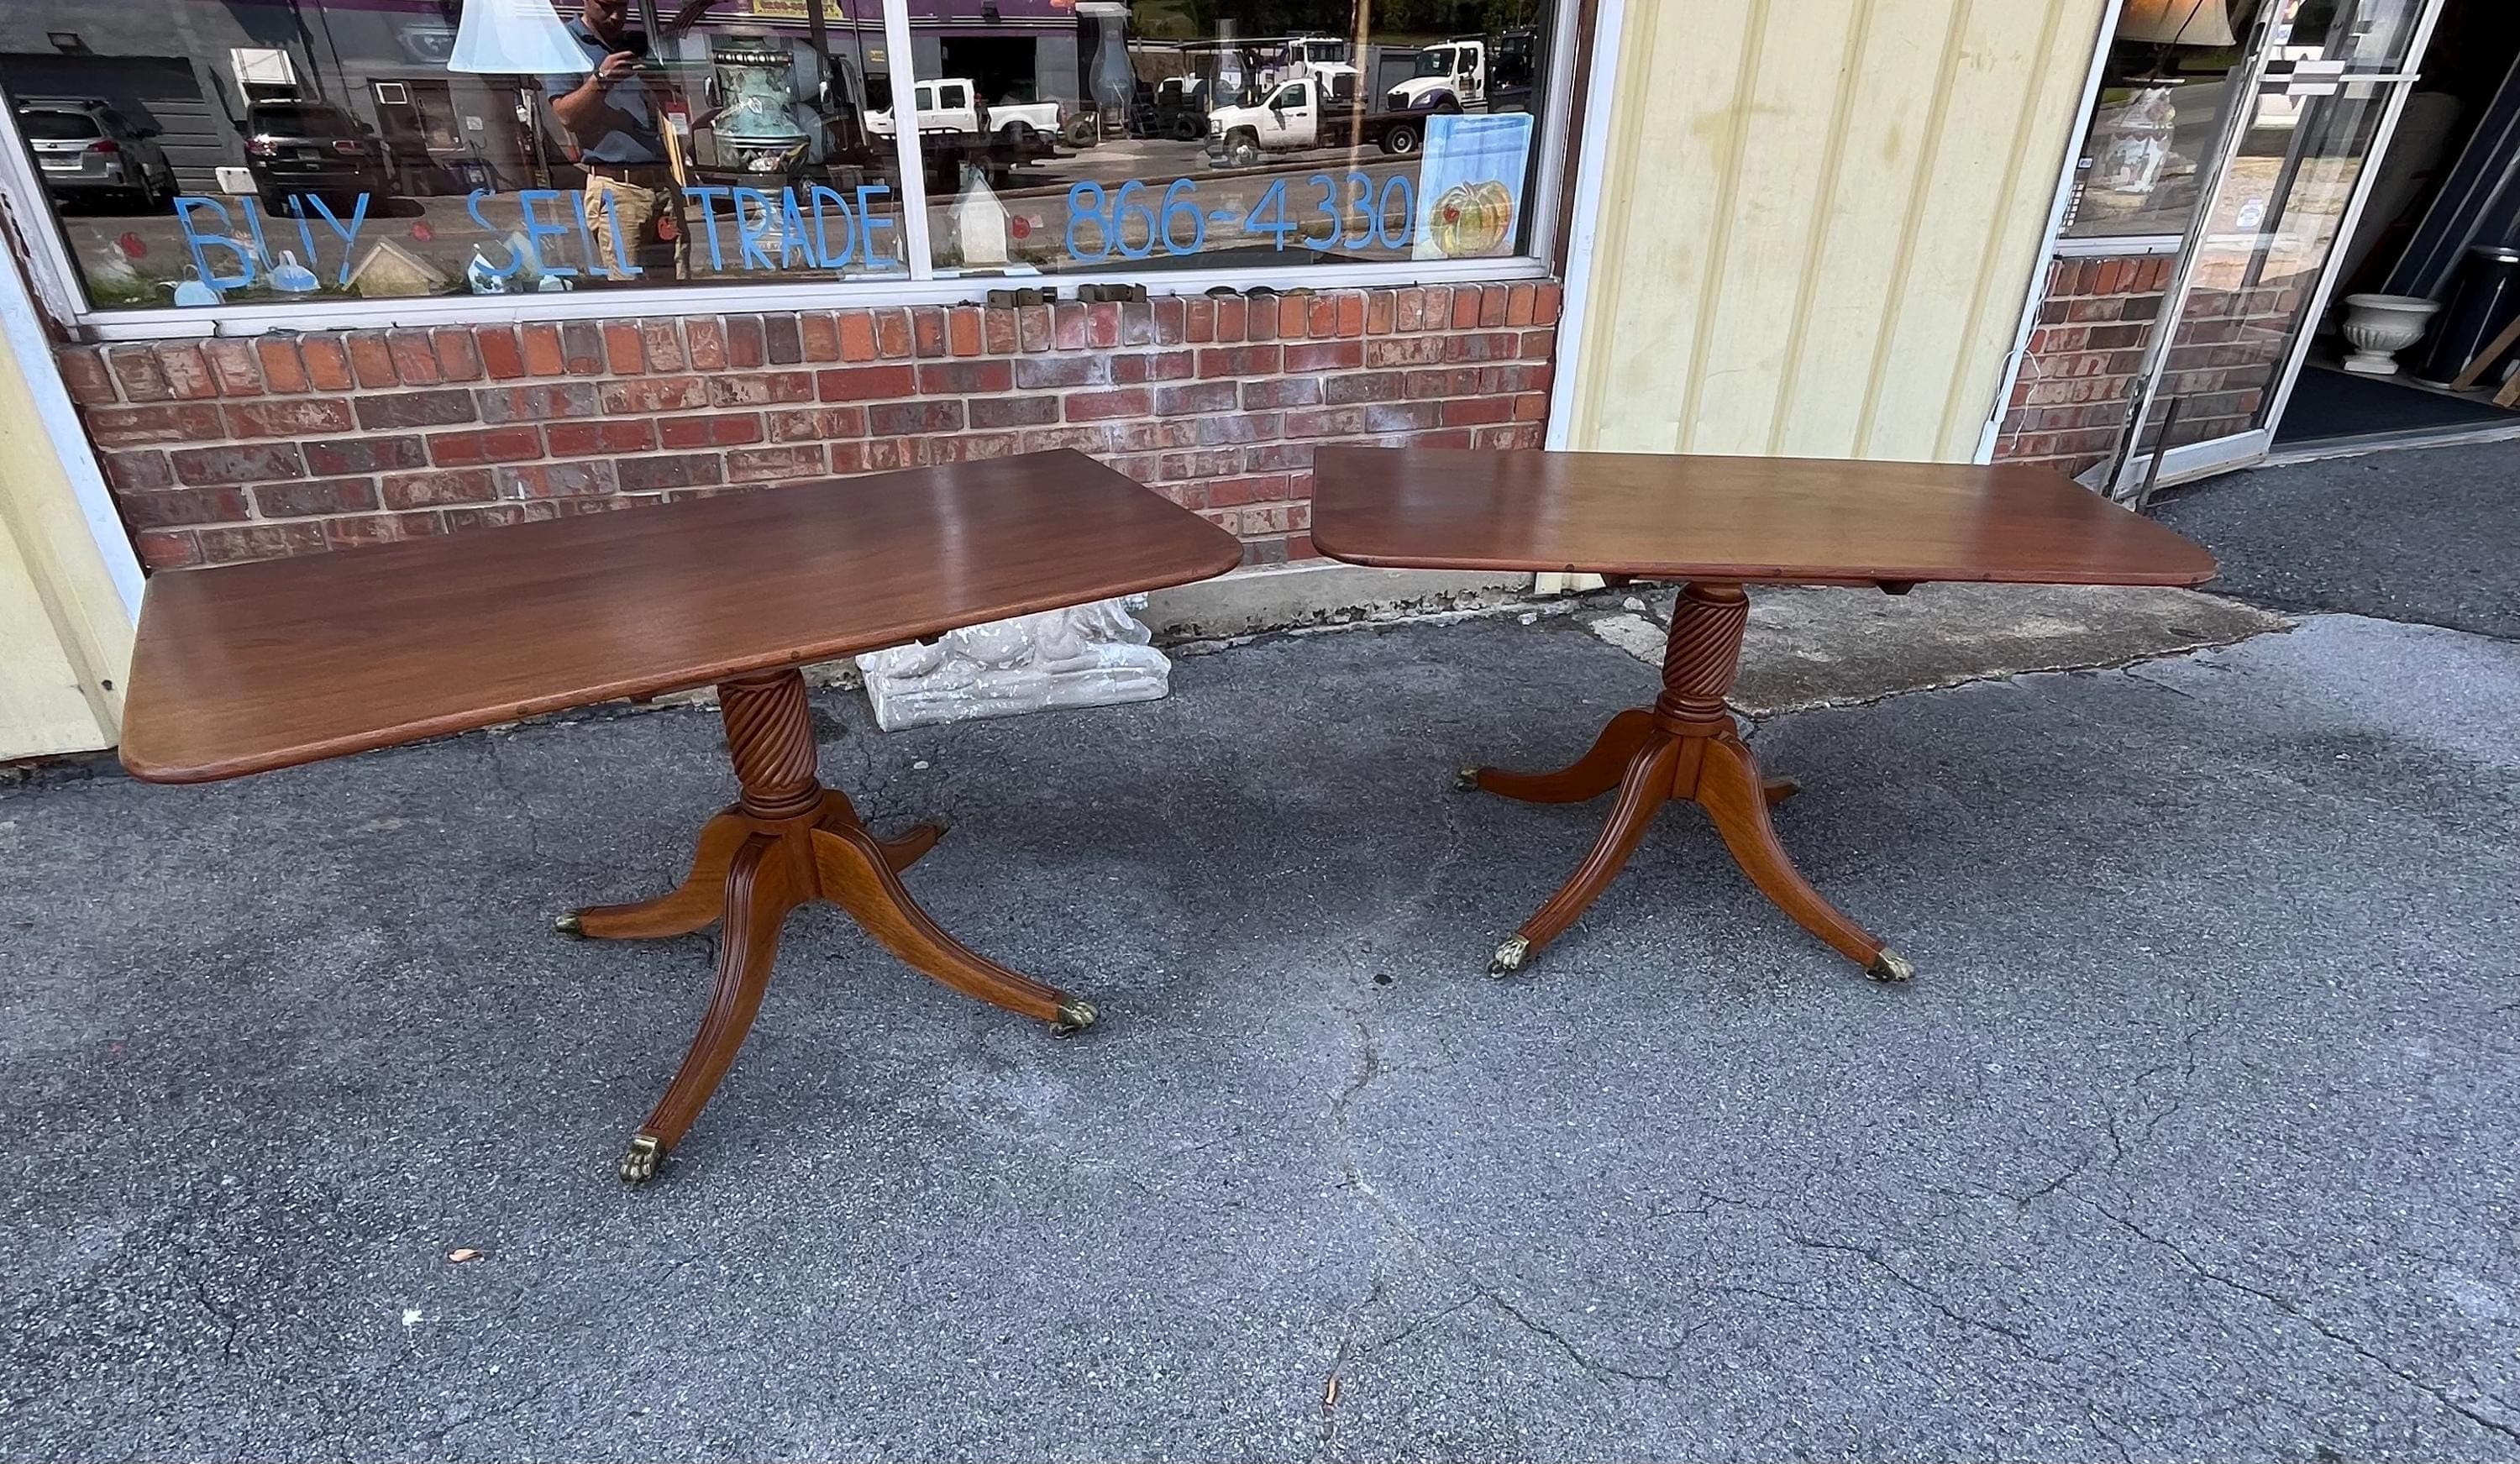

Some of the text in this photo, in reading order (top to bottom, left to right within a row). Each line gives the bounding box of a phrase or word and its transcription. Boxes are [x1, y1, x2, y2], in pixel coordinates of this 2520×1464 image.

[173, 185, 899, 291] BUY SELL TRADE
[1065, 171, 1415, 264] 866-4330
